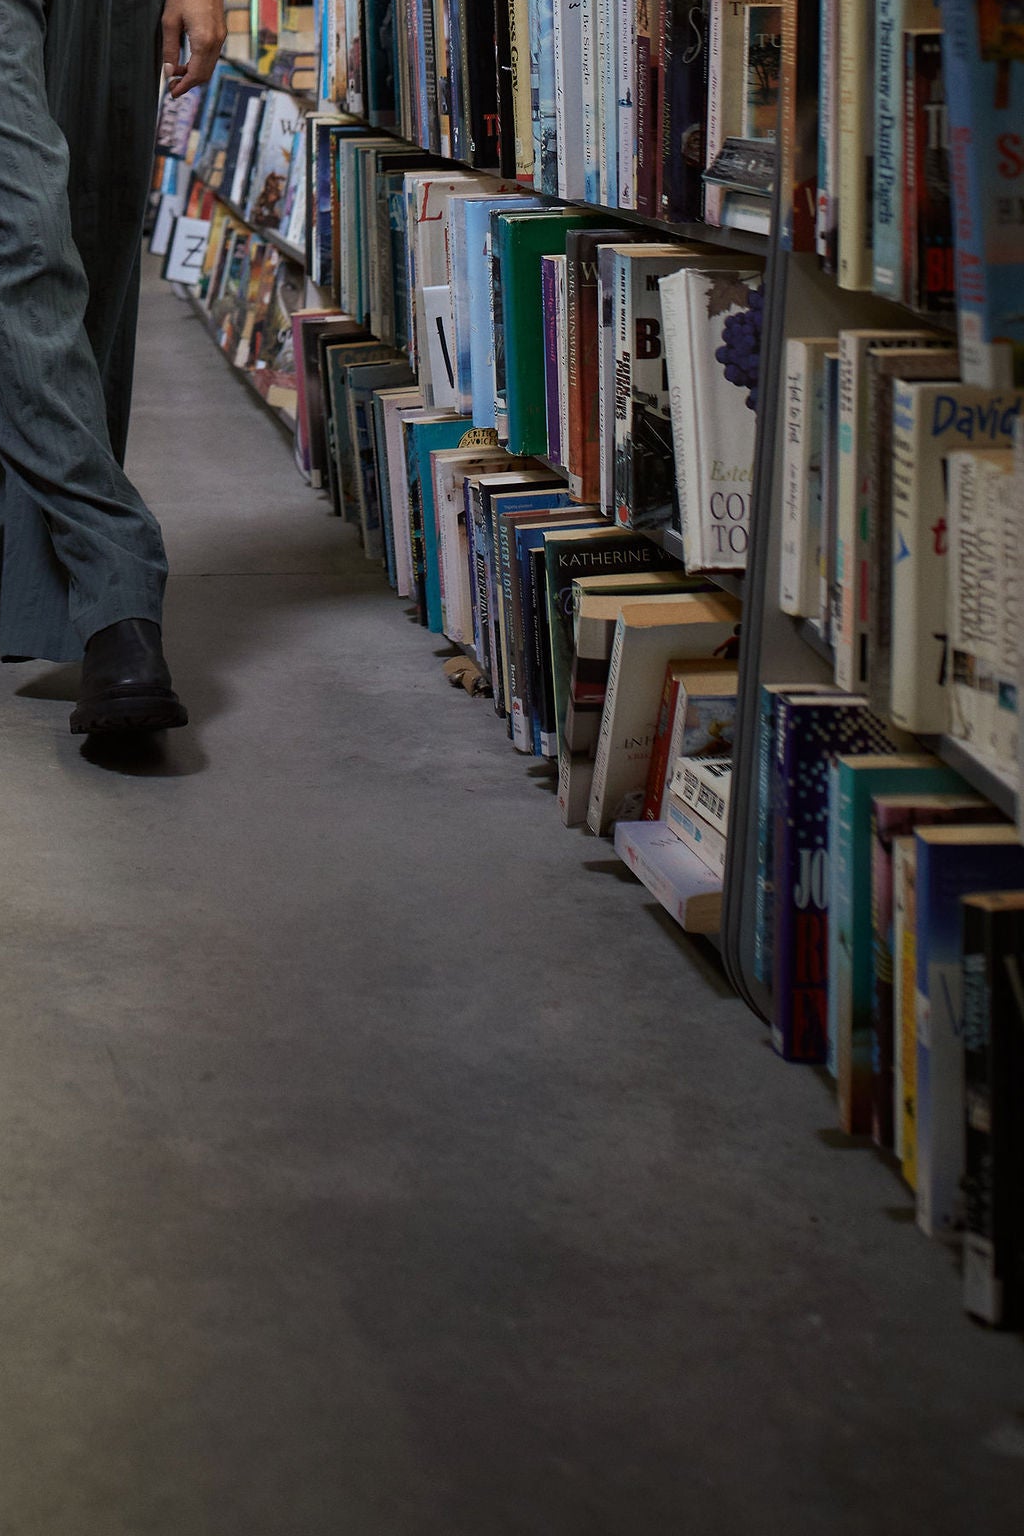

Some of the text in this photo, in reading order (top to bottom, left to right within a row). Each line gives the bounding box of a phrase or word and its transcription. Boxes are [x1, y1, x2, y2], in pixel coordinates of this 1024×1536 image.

[582, 13, 590, 34] Be
[510, 46, 520, 91] Gray
[581, 36, 591, 85] Single
[878, 19, 893, 97] Testimony
[880, 99, 889, 114] of
[879, 115, 893, 171] Daniel
[619, 268, 627, 305] MARTYN
[567, 259, 577, 387] MARK WAINWRIGHT
[615, 359, 625, 421] PUNCHES
[621, 351, 631, 396] BORN
[499, 526, 511, 569] DESERT
[558, 550, 650, 568] KATHERINE
[710, 525, 748, 553] TO
[477, 558, 488, 627] DECEPTIONS
[502, 573, 512, 601] LOST
[528, 555, 537, 586] Charles
[533, 629, 541, 666] Graduate
[601, 703, 611, 736] JACK
